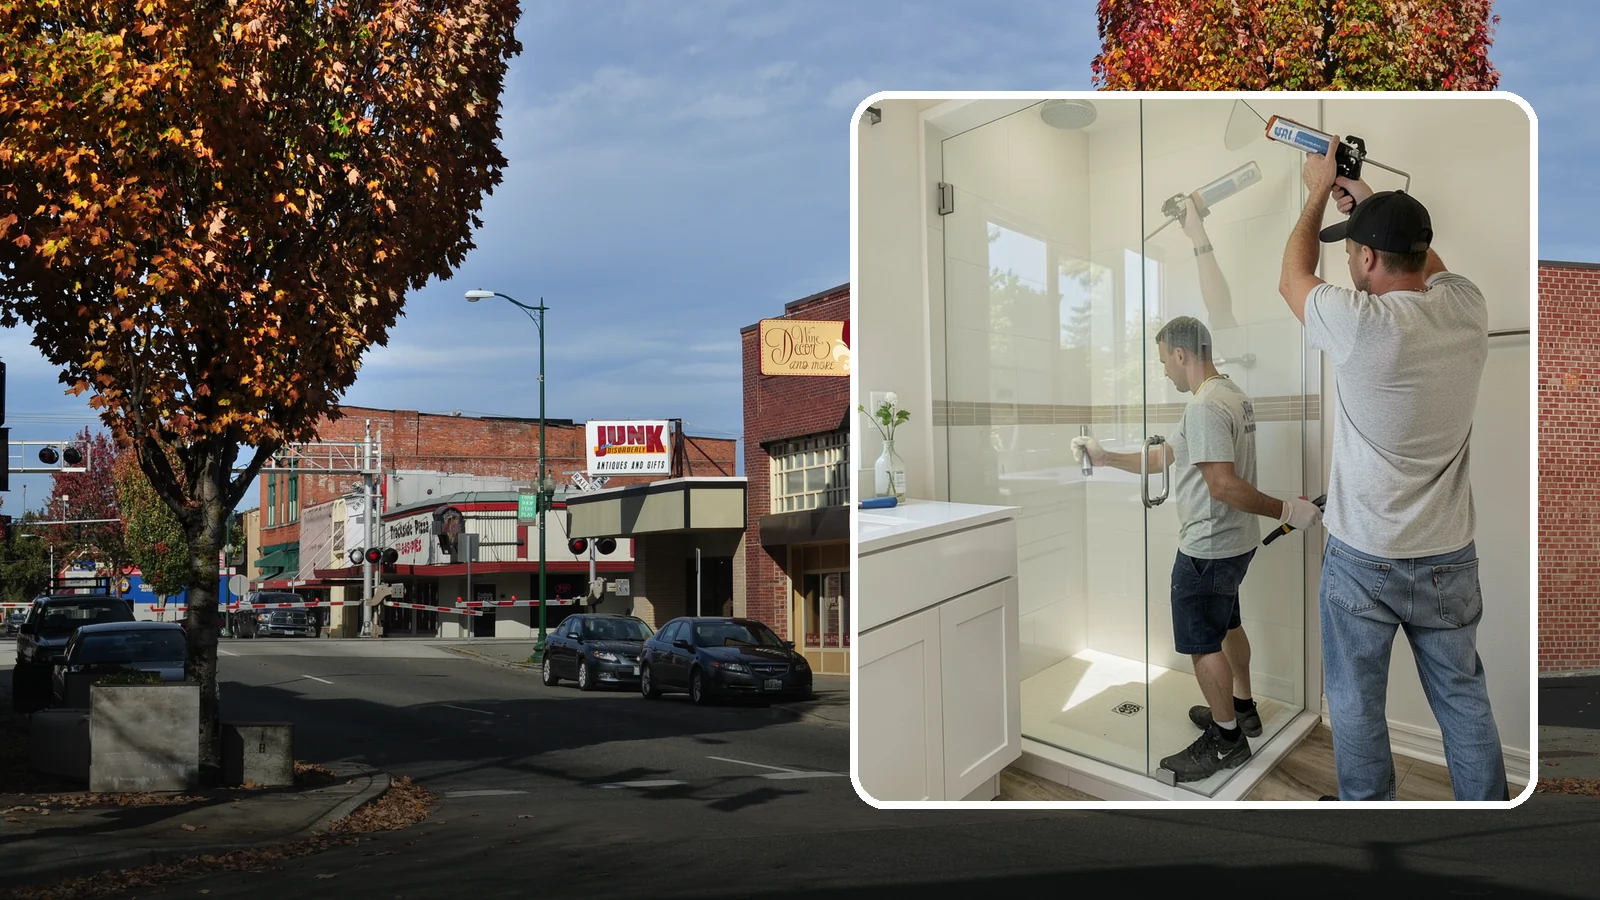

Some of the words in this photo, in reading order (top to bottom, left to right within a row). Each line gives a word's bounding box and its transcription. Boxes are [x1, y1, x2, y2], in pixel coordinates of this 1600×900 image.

[764, 327, 831, 365] Decor
[595, 425, 665, 457] JUNK
[607, 446, 646, 454] DISORDERLY
[597, 461, 628, 470] ANTIQUES
[631, 461, 644, 470] AND
[647, 460, 665, 469] GIFTS
[390, 521, 413, 539] Trackside
[414, 519, 429, 535] Pizza
